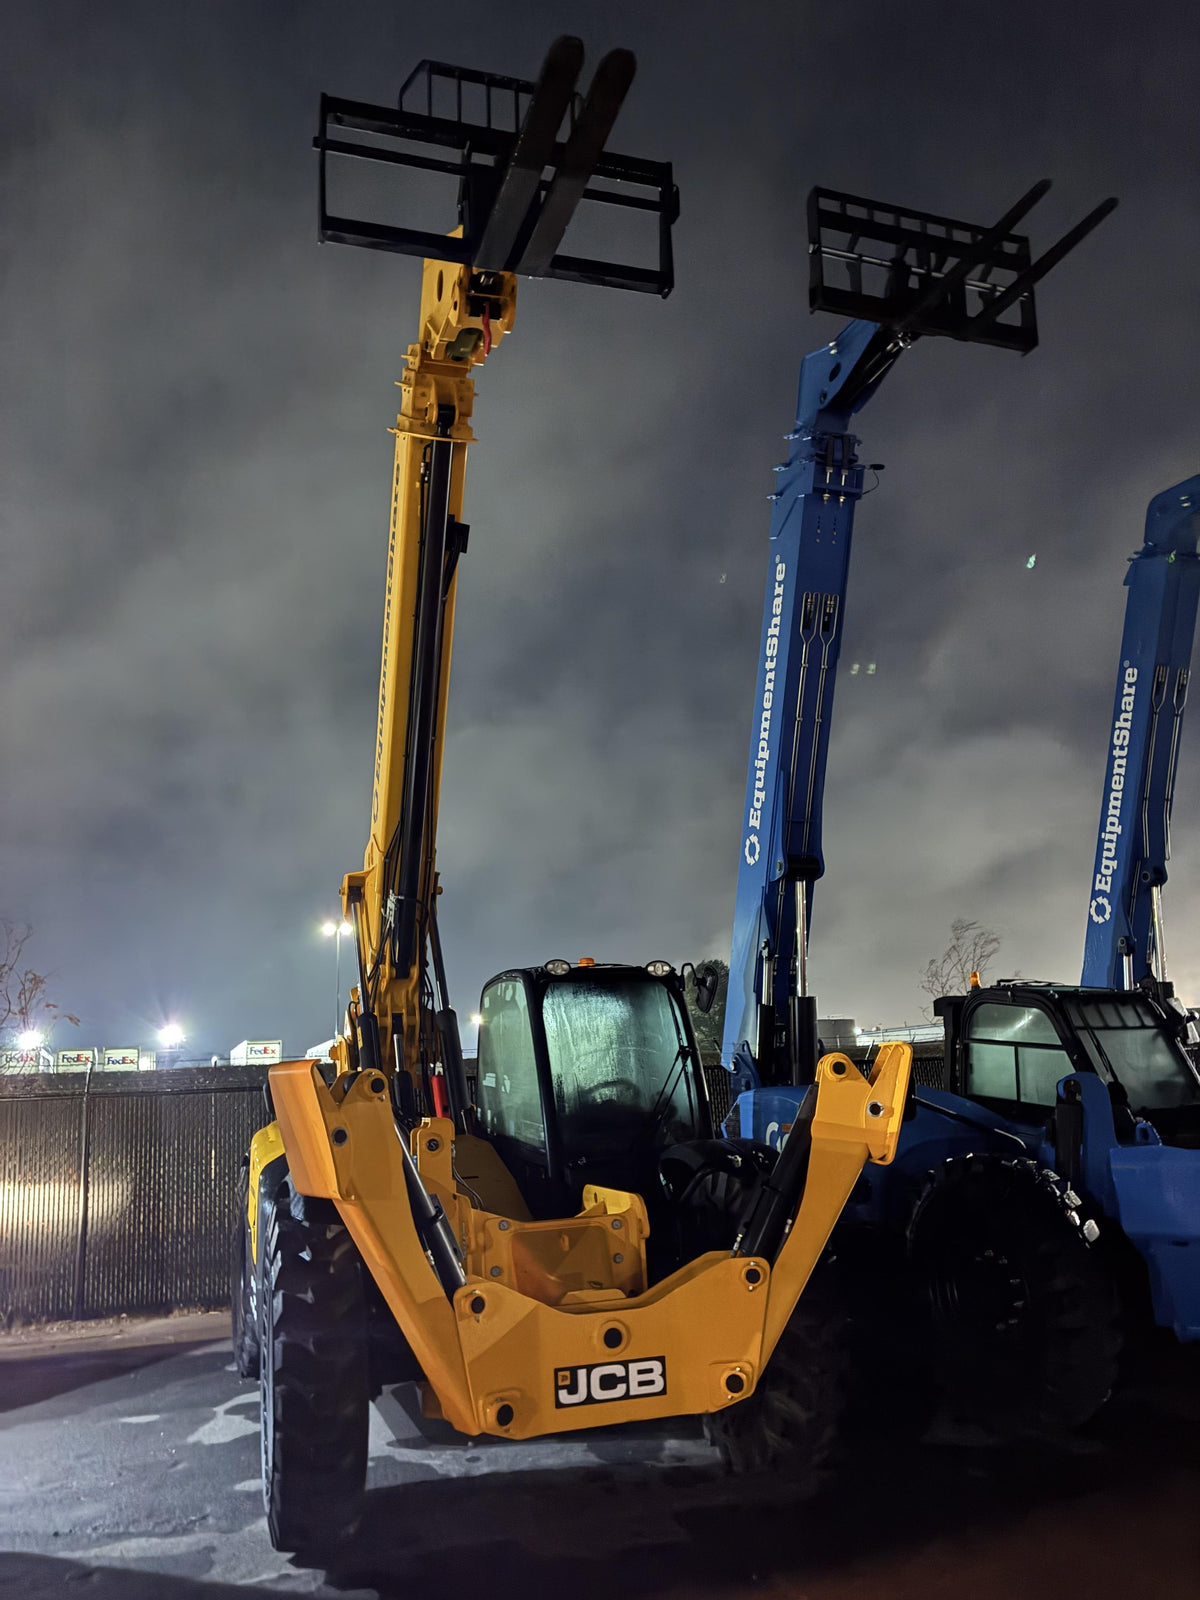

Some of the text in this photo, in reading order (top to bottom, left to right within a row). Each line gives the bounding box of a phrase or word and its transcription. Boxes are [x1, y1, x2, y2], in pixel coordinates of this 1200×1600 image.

[749, 563, 786, 830] EquipmentShare
[1095, 667, 1138, 893] EquipmentShare
[62, 1053, 90, 1063] FedEx
[107, 1056, 137, 1065] FedEx
[250, 1046, 276, 1055] FedEx
[557, 1360, 665, 1405] JCB
